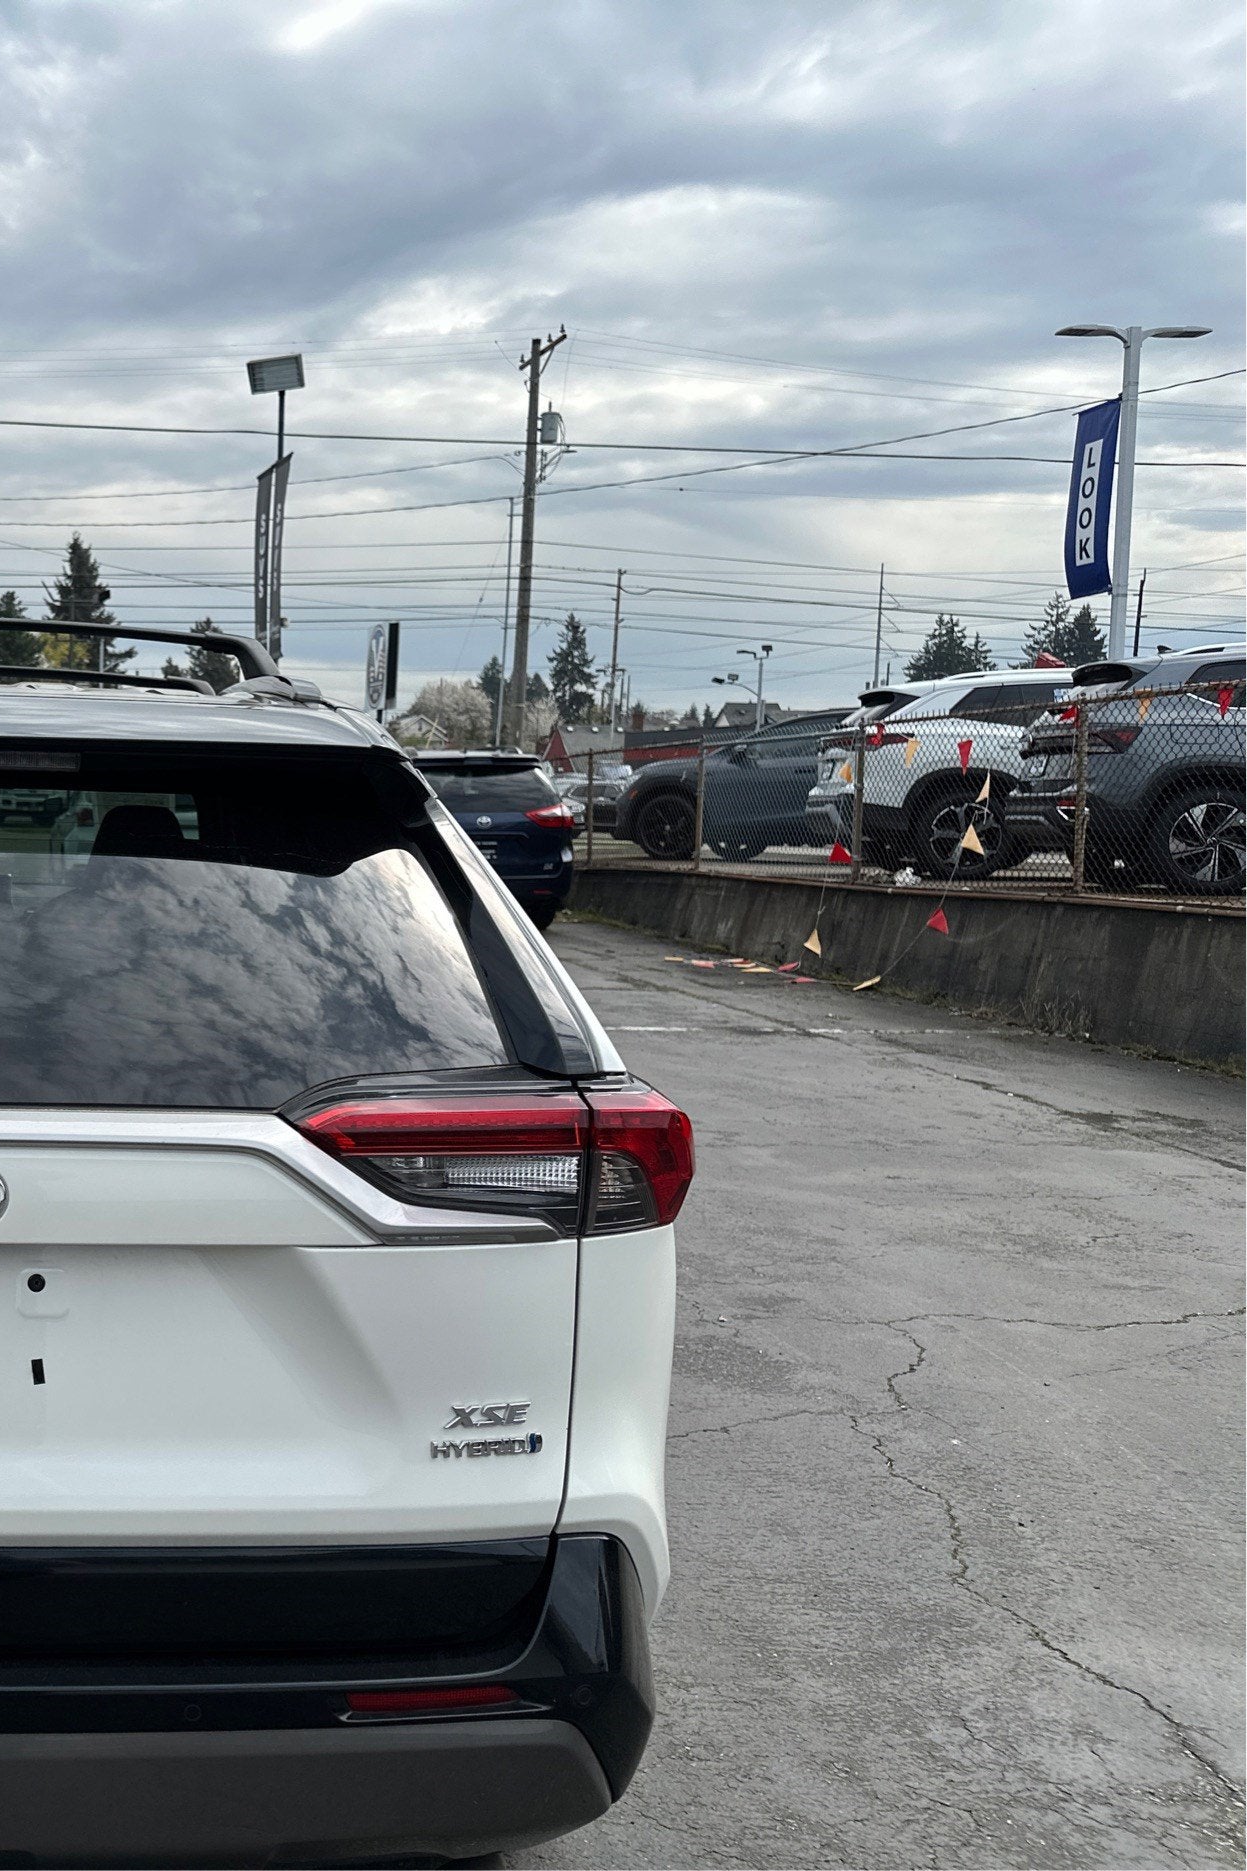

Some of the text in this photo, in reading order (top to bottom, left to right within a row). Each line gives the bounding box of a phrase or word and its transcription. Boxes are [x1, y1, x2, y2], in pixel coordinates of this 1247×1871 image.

[1078, 446, 1096, 561] LOOK
[443, 1401, 532, 1429] XSE
[431, 1437, 526, 1459] HYBRID
